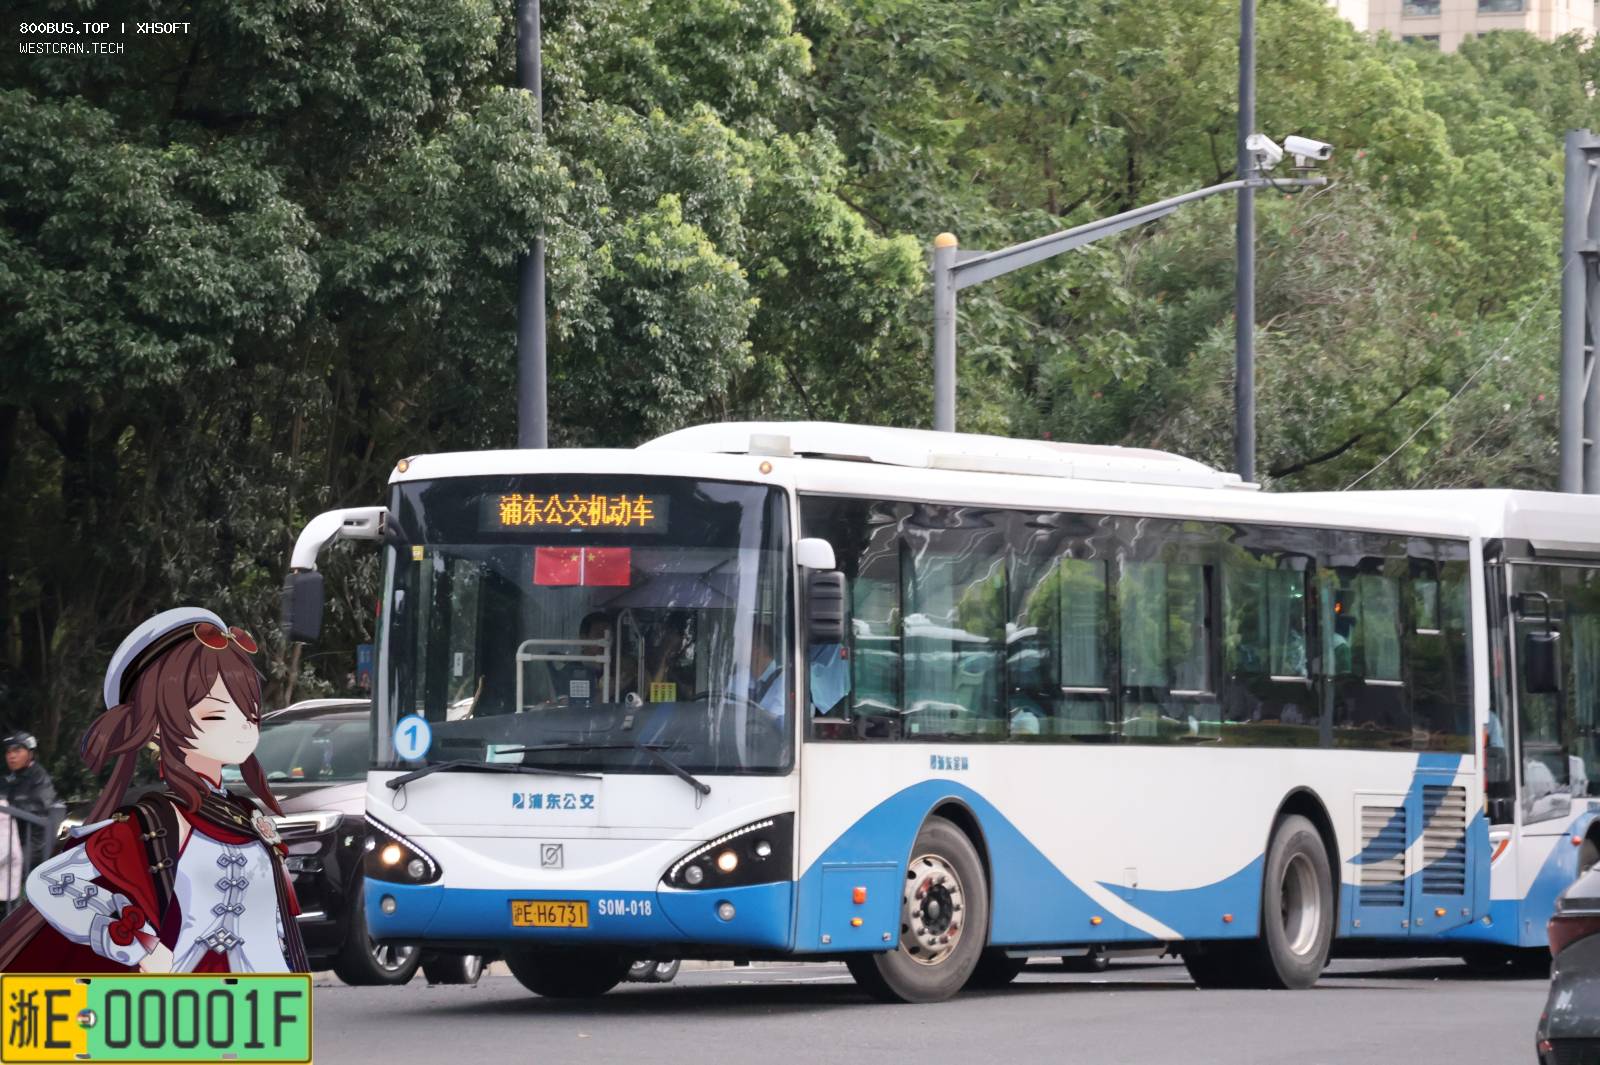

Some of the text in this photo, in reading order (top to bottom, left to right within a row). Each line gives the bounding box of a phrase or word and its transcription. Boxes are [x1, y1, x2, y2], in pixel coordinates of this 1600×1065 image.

[500, 494, 654, 526] 浦东公交机动车
[528, 793, 594, 809] 浦东公交
